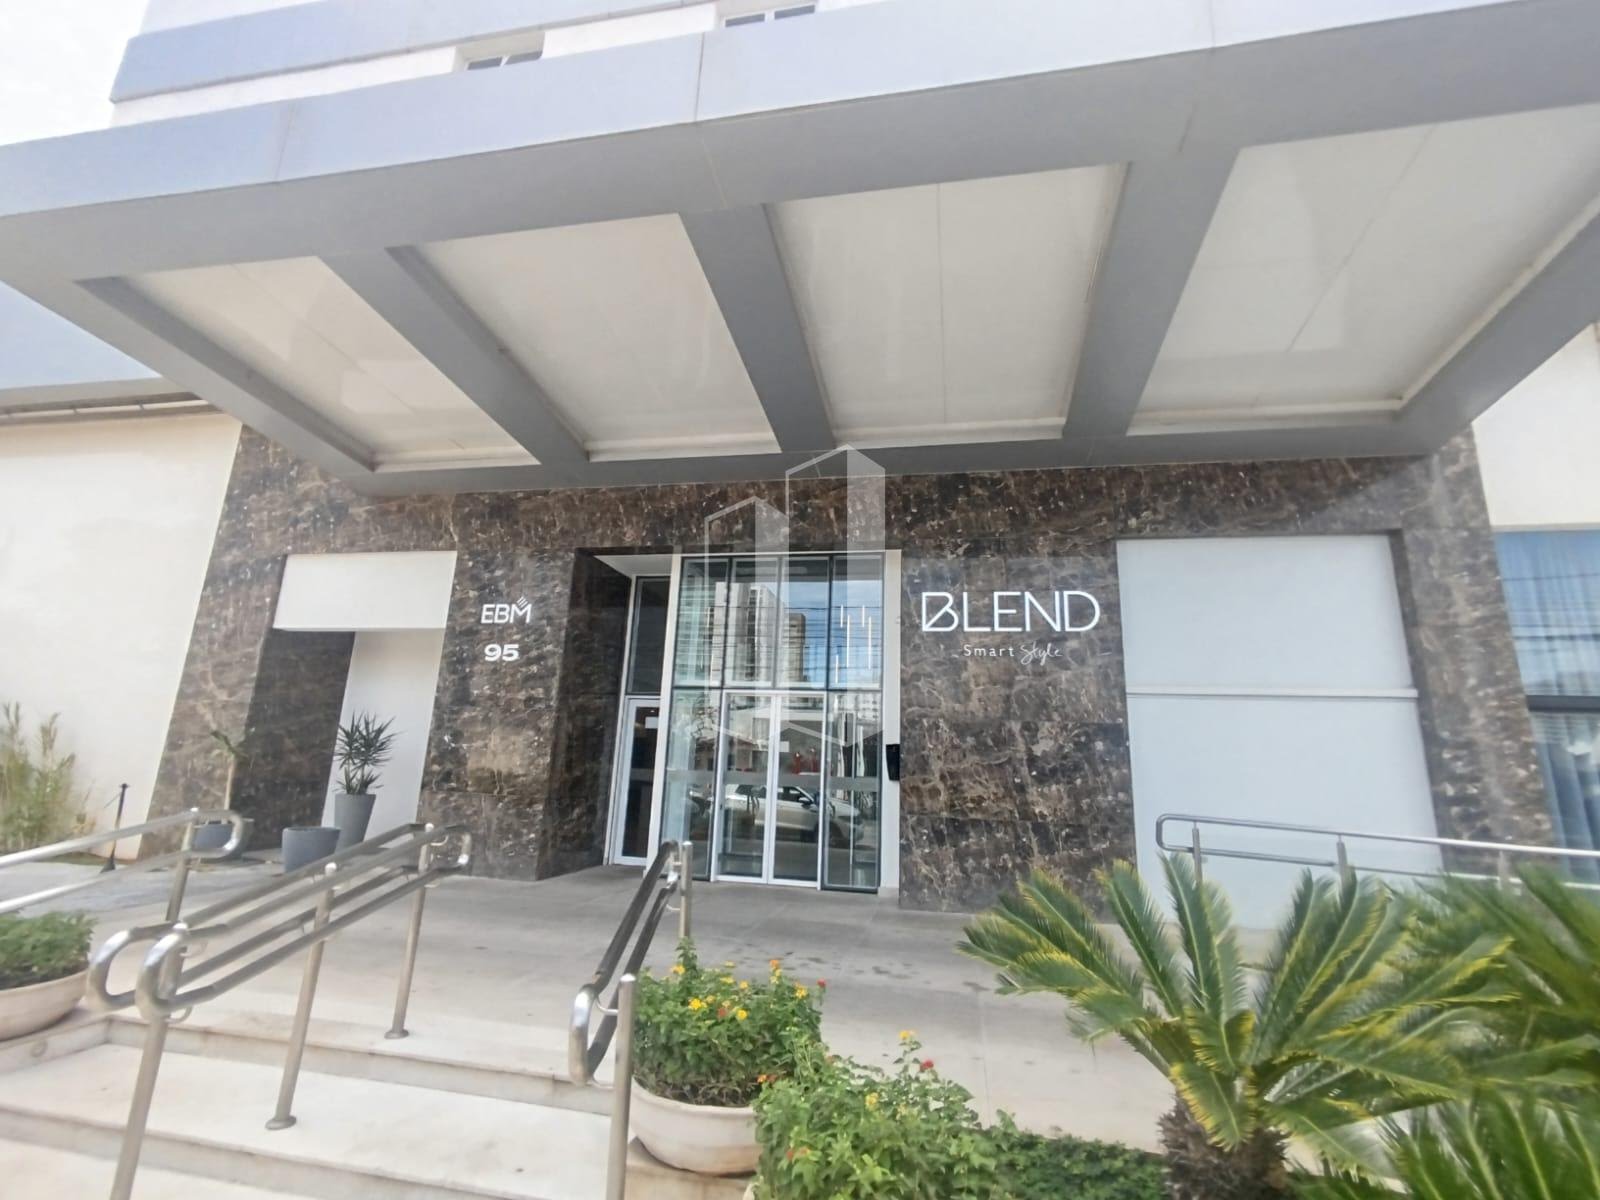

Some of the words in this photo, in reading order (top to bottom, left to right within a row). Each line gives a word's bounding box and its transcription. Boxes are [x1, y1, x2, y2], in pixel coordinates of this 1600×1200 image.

[481, 602, 532, 624] EBM
[921, 590, 1101, 632] BLEND
[484, 644, 520, 661] 95
[963, 644, 1015, 657] Smart
[1019, 642, 1063, 665] Style
